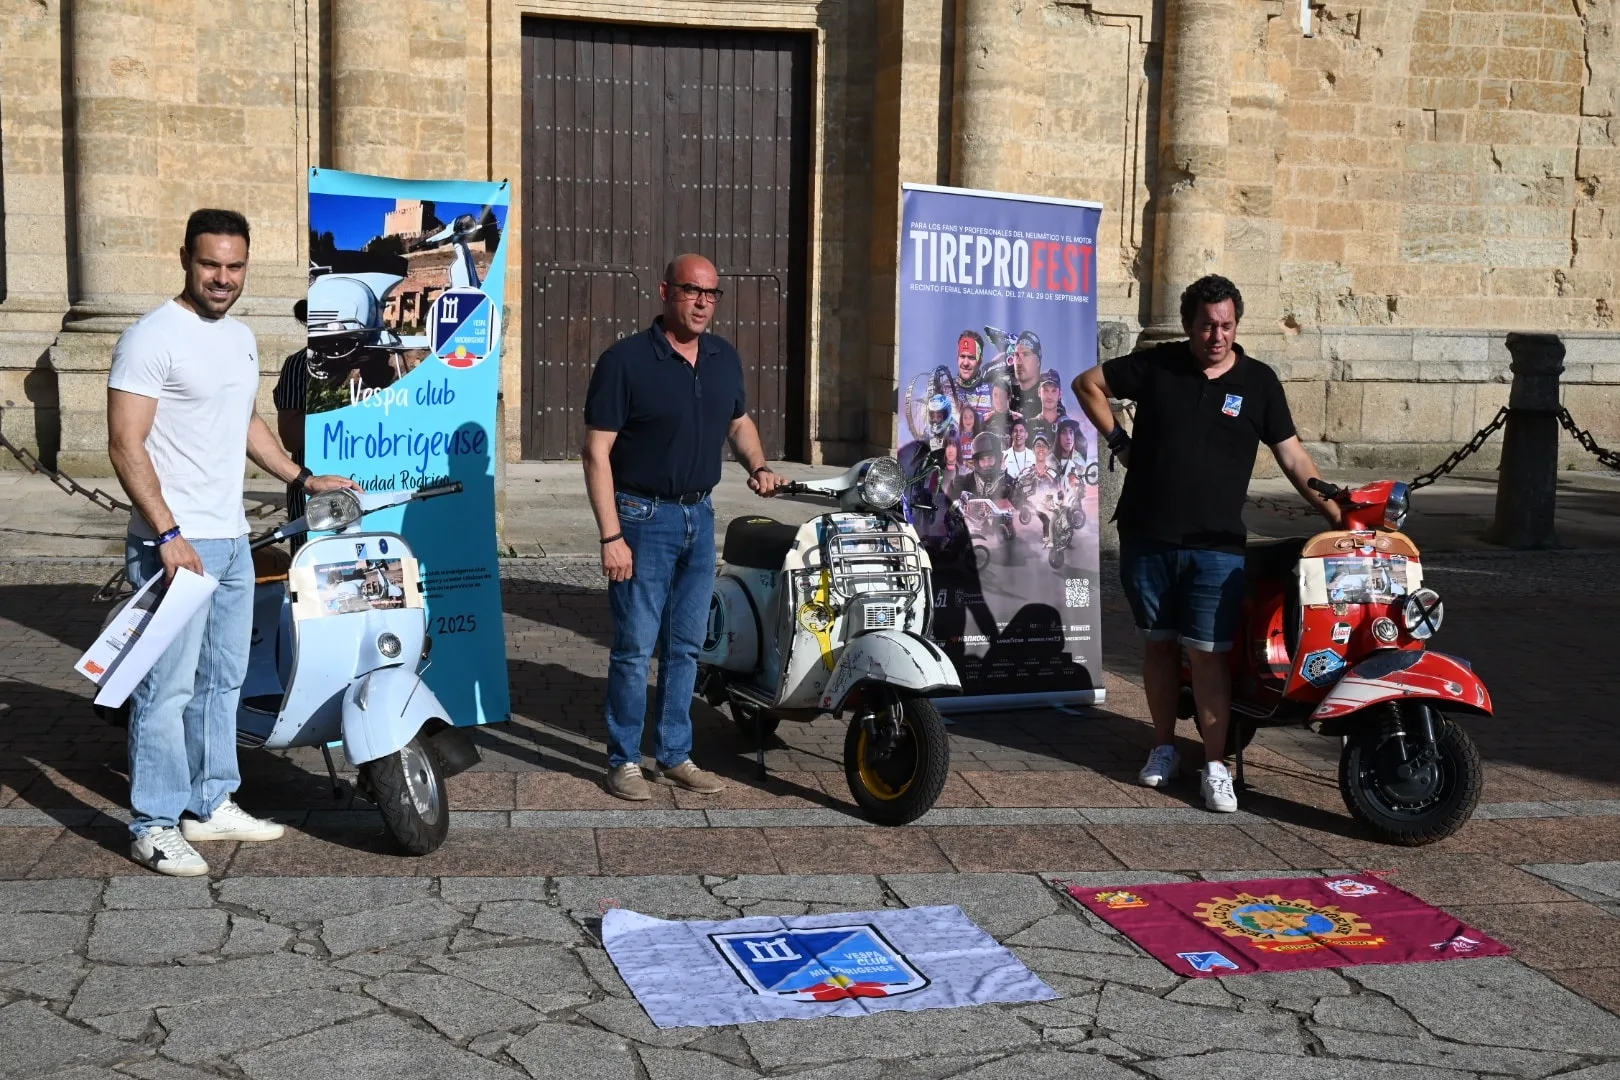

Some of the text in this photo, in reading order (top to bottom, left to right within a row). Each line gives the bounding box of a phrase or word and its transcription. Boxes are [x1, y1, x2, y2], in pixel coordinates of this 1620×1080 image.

[910, 222, 927, 230] PARA
[928, 223, 941, 231] LOS
[942, 224, 958, 232] FANS
[959, 225, 964, 233] Y
[964, 226, 1012, 237] PROFESIONALES
[1013, 230, 1024, 239] DEL
[1065, 235, 1073, 243] EL
[1073, 236, 1093, 245] MOTOR
[910, 283, 940, 292] RECINTO
[940, 285, 962, 294] FERIAL
[1005, 290, 1016, 298] DEL
[1017, 291, 1025, 299] 27
[1054, 293, 1089, 303] SEPTIEMBRE
[350, 377, 455, 416] Vespa club
[323, 419, 486, 473] Mirobrigense
[437, 614, 477, 635] 2025
[843, 950, 881, 960] VESPA
[857, 956, 889, 966] CLUB
